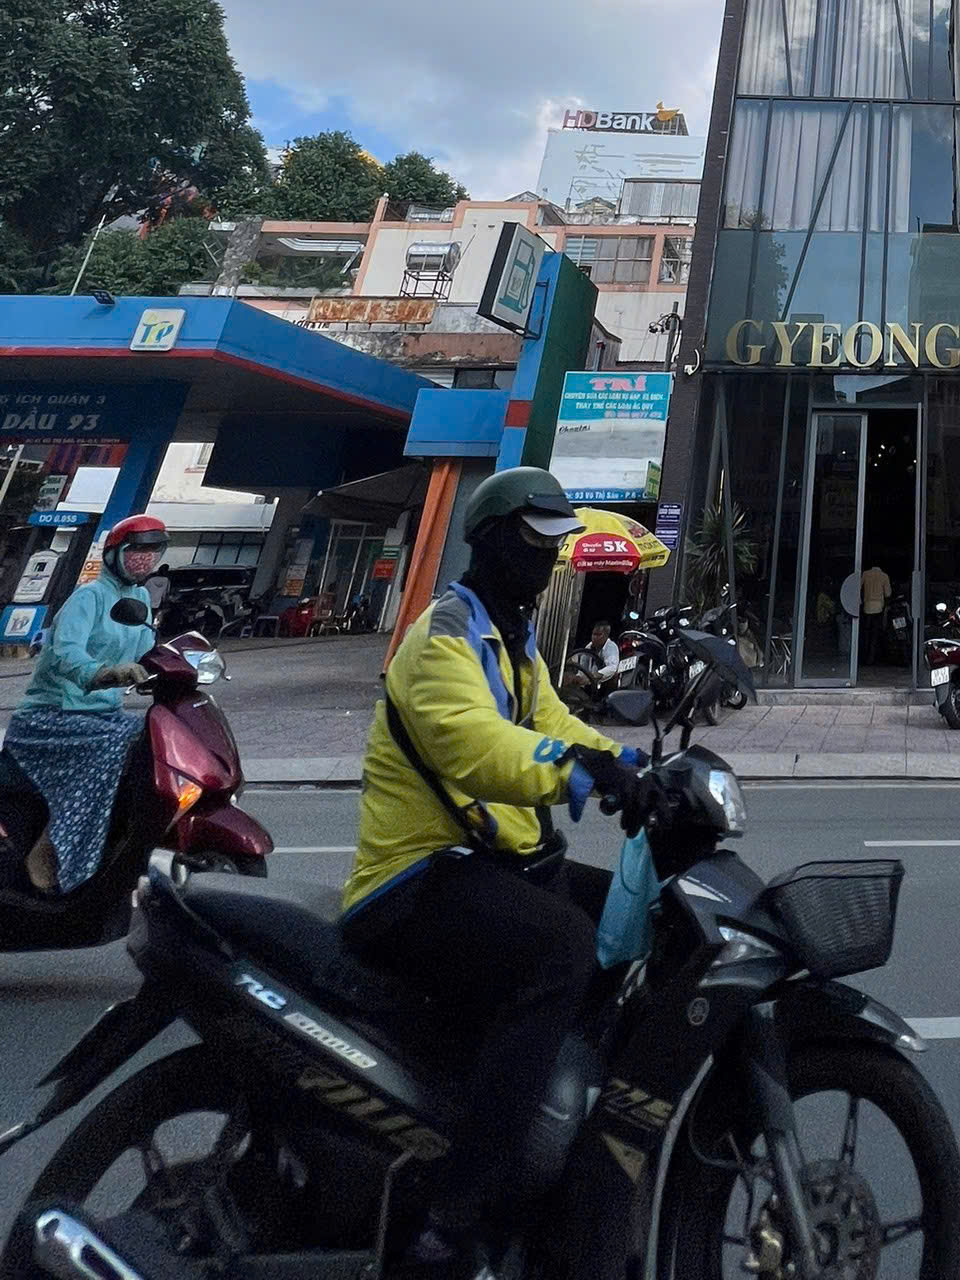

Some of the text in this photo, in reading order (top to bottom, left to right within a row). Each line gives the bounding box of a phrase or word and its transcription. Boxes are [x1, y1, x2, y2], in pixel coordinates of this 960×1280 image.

[563, 110, 655, 131] HDBank
[96, 395, 106, 404] 3
[66, 414, 101, 430] 93
[39, 514, 53, 523] DO
[603, 540, 628, 552] 5K
